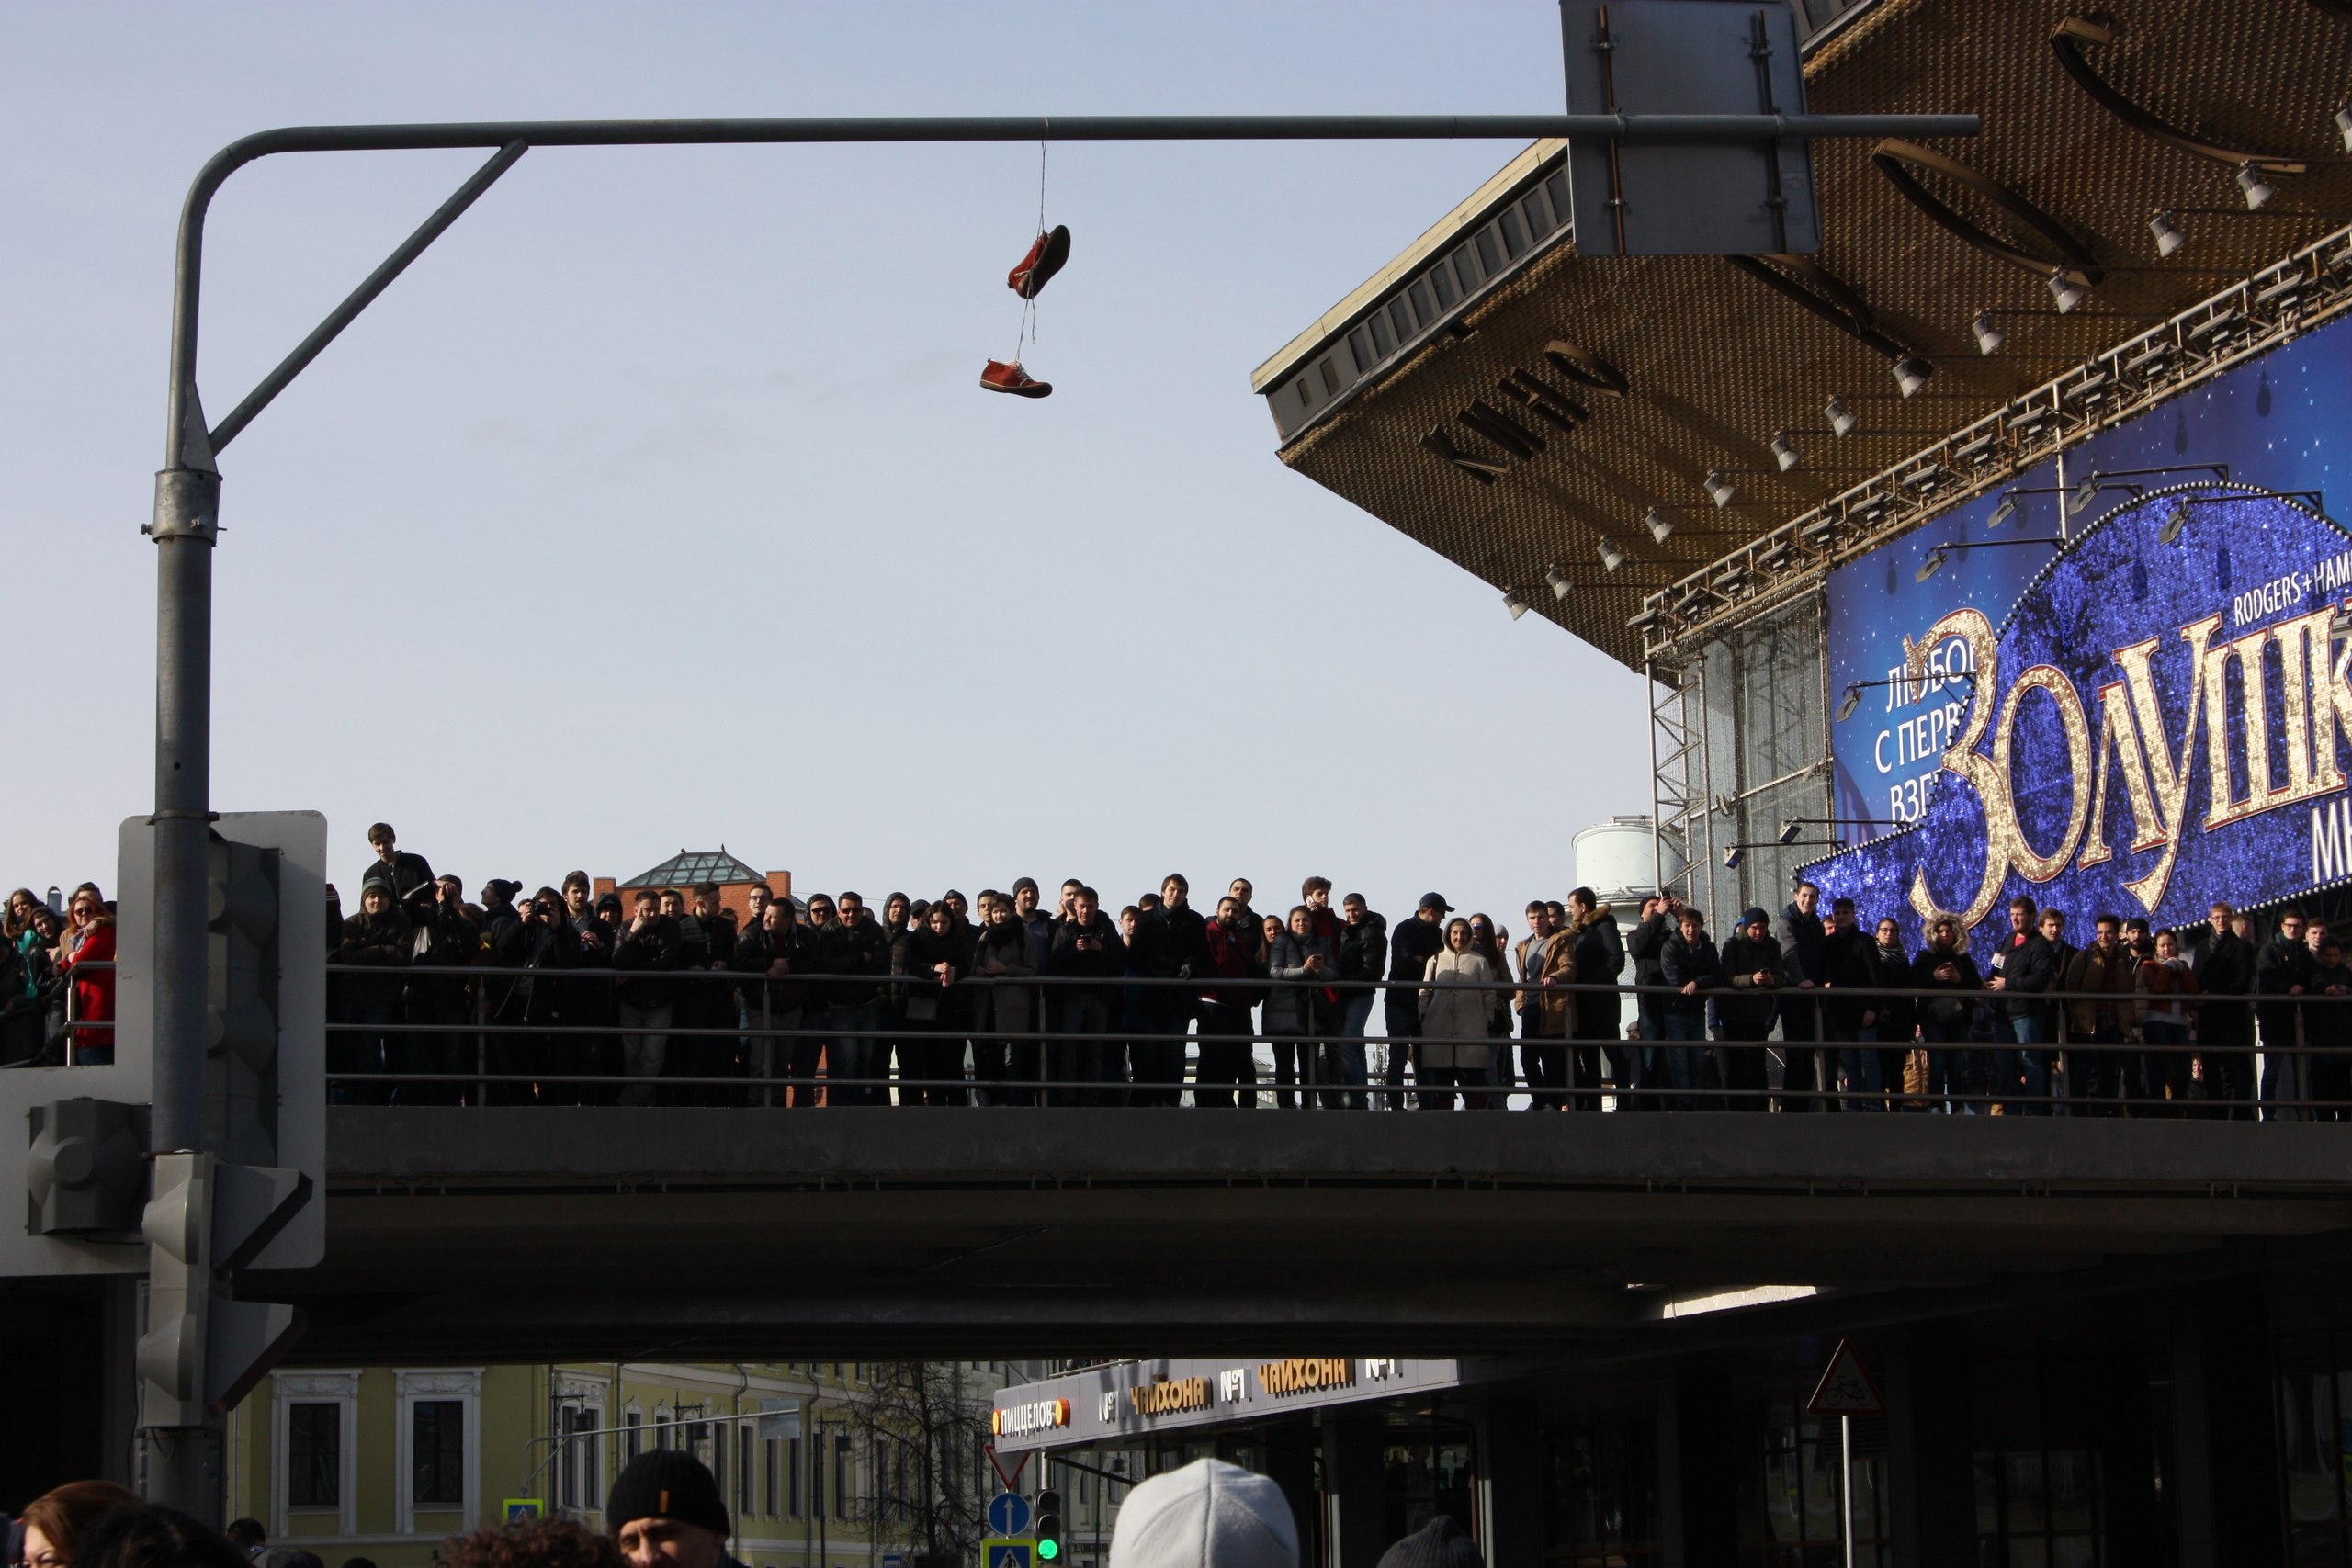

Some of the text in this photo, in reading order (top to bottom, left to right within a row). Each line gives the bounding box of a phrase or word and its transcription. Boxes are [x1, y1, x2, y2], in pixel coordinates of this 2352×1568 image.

[2234, 571, 2301, 626] RODGERS
[2314, 548, 2352, 594] HAM
[1875, 699, 1969, 773] С ПЕРВ
[1890, 769, 1943, 829] ВЗГ
[1001, 1401, 1053, 1437] ПИЦЦЕЛОВ
[1130, 1374, 1204, 1415] ЧАЙХОНА
